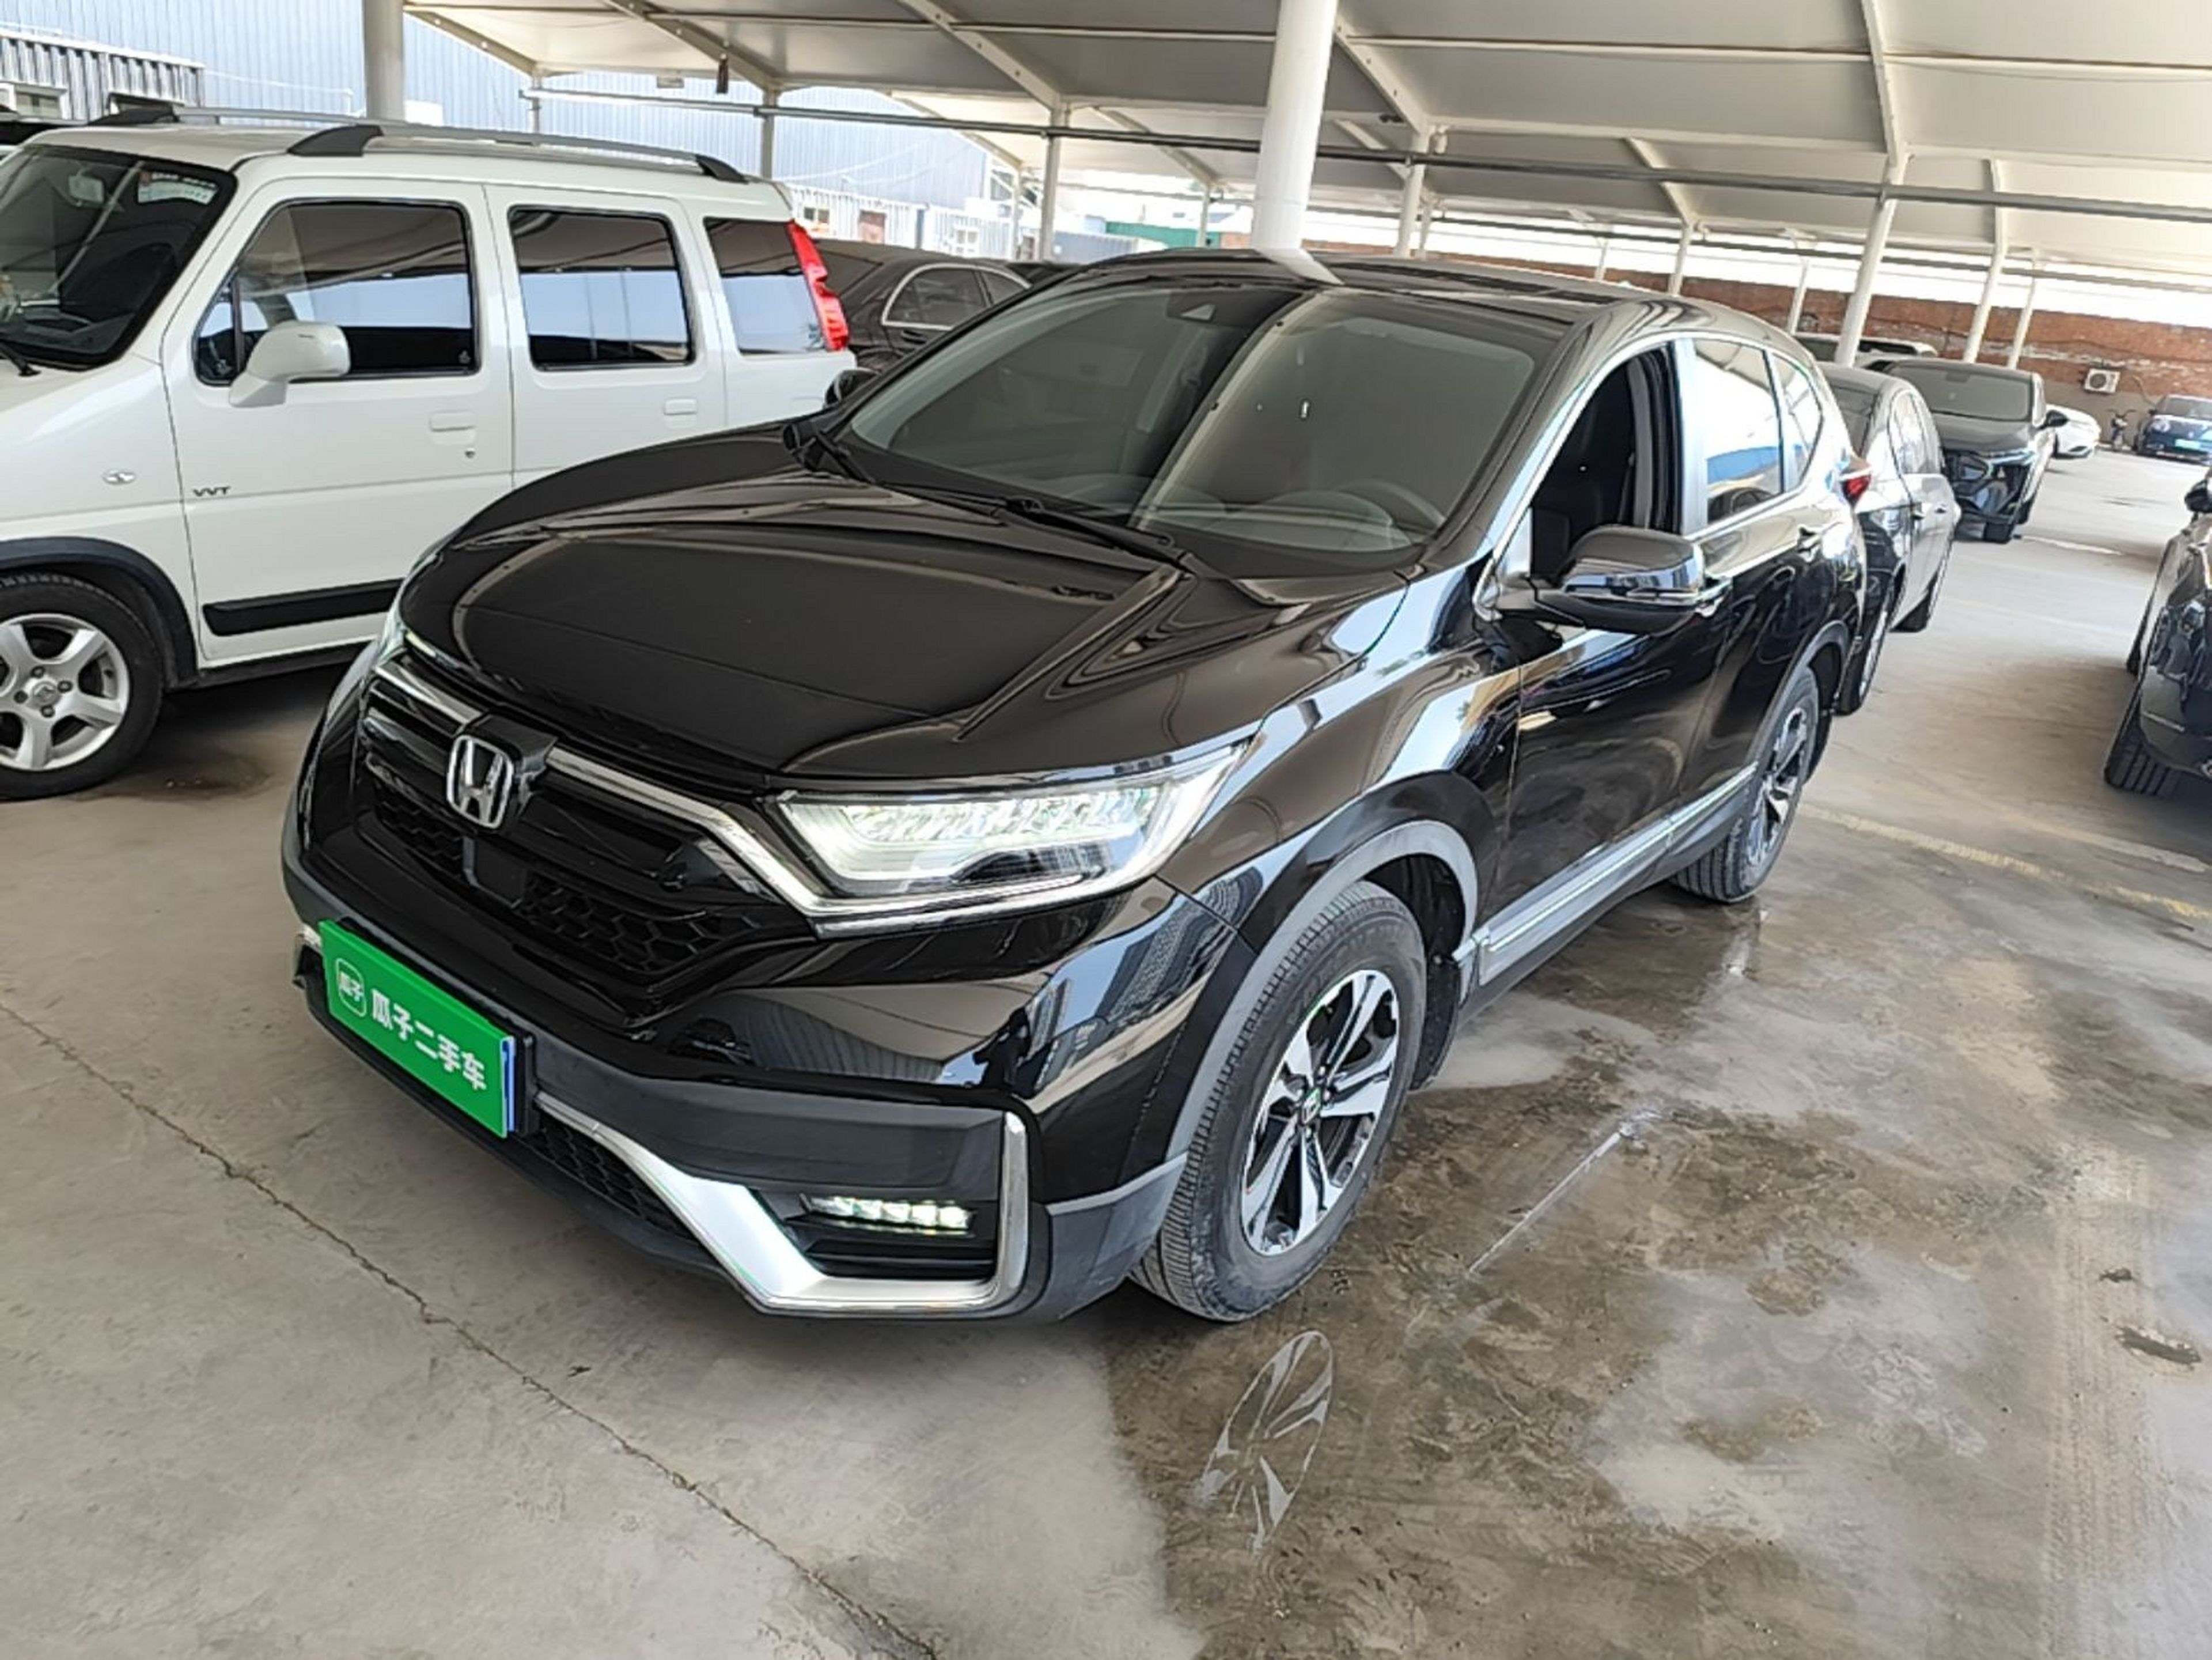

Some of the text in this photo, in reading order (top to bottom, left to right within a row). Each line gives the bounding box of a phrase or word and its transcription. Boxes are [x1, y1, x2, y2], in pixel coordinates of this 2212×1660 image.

[372, 988, 487, 1090] 瓜子二手车
